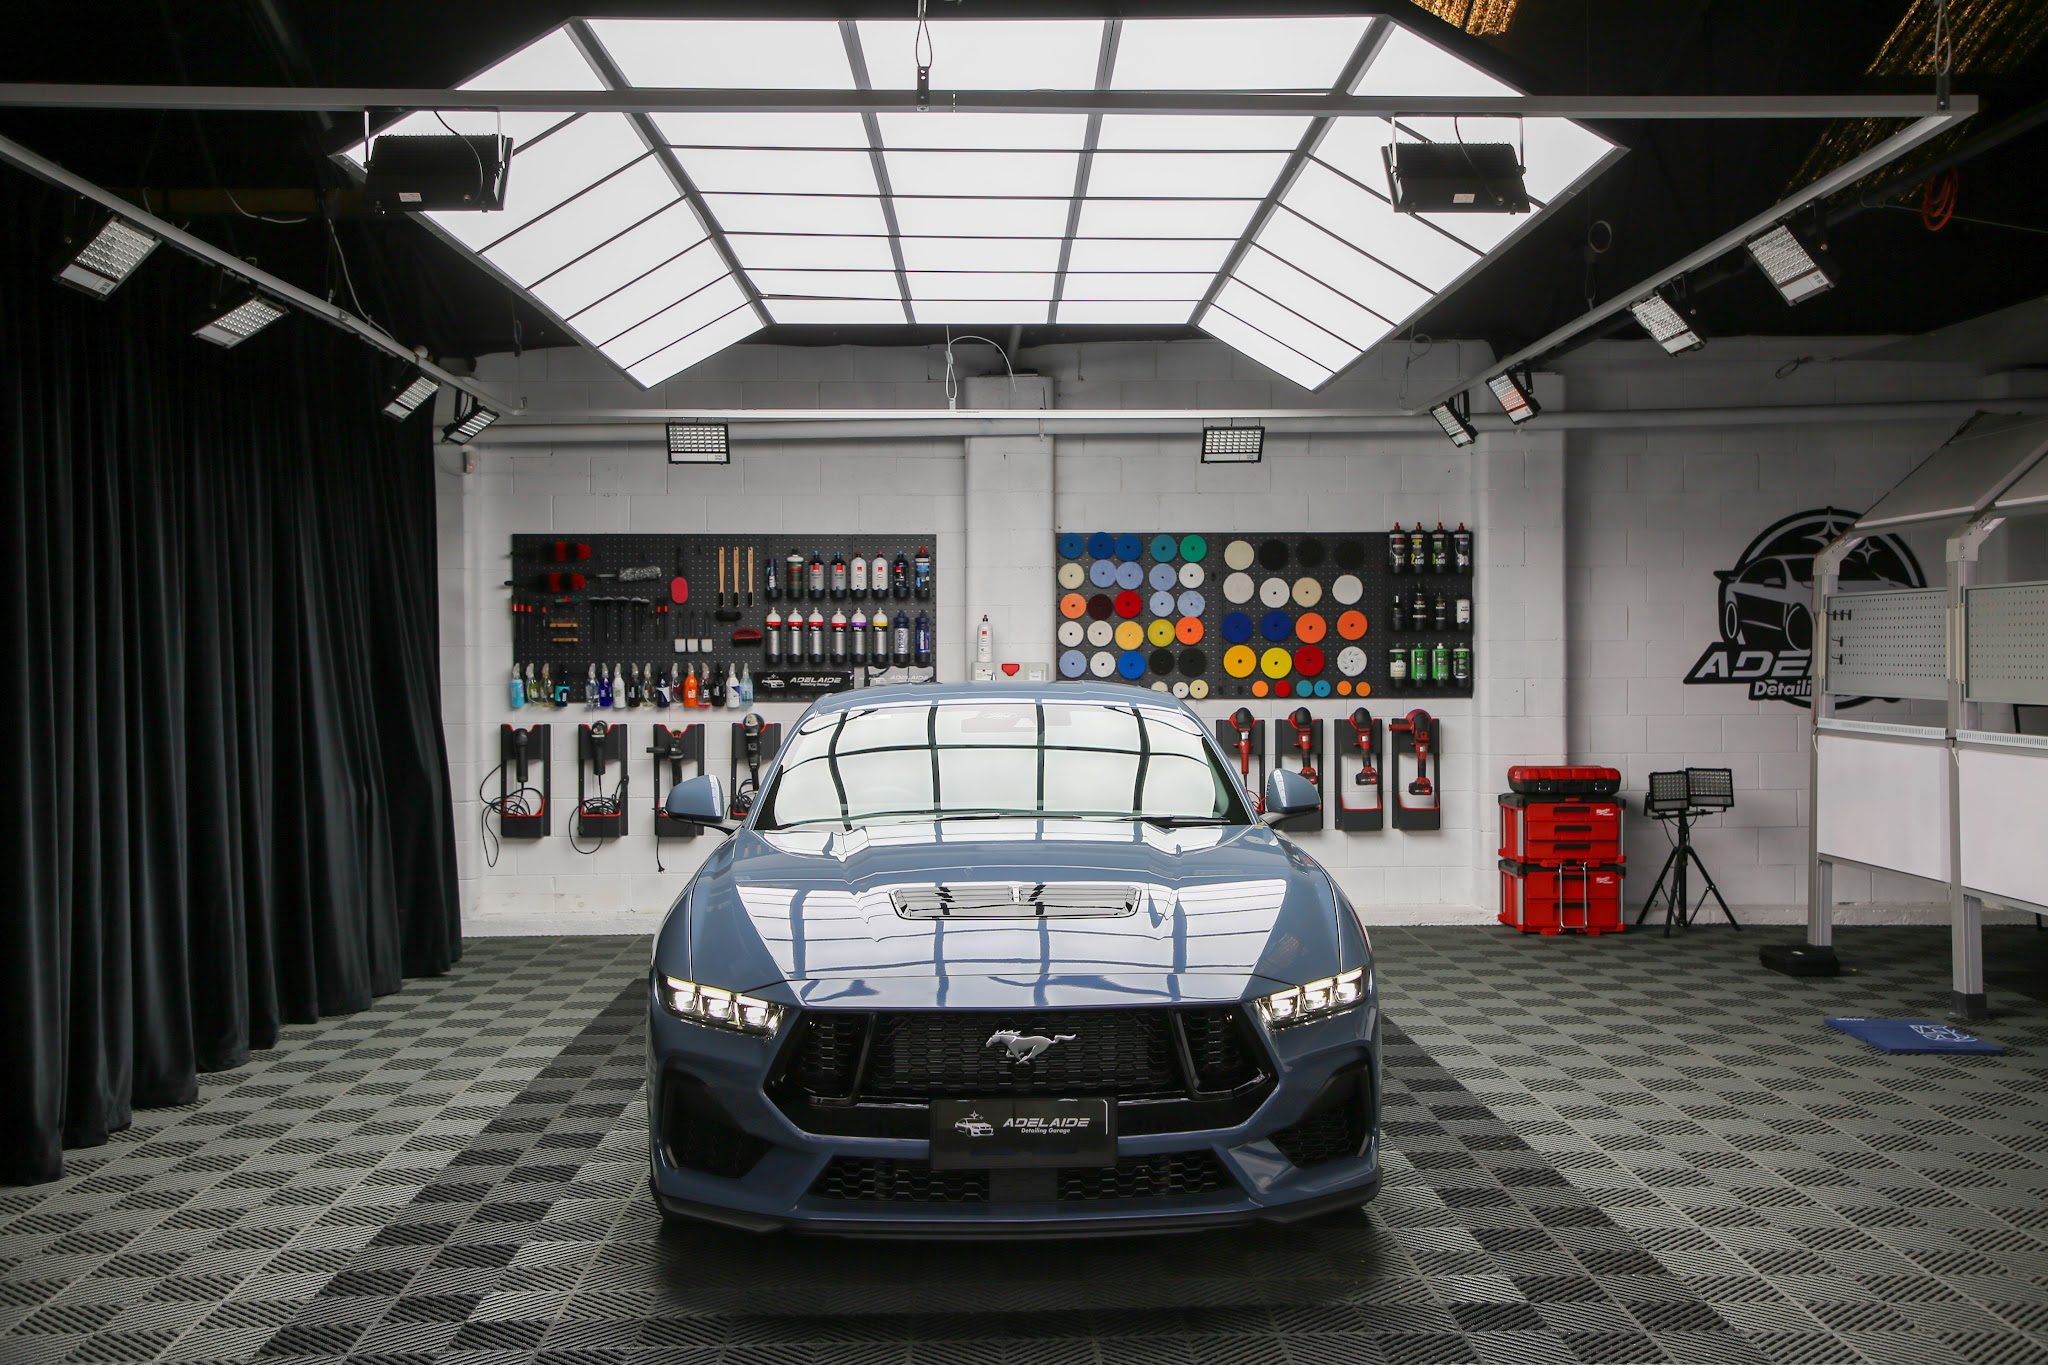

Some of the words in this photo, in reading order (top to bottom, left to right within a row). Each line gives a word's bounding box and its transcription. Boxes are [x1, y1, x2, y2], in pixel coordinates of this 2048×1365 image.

[1694, 650, 1812, 678] ADE
[1754, 679, 1812, 696] Detaili
[1002, 1117, 1091, 1127] ADELAIDE
